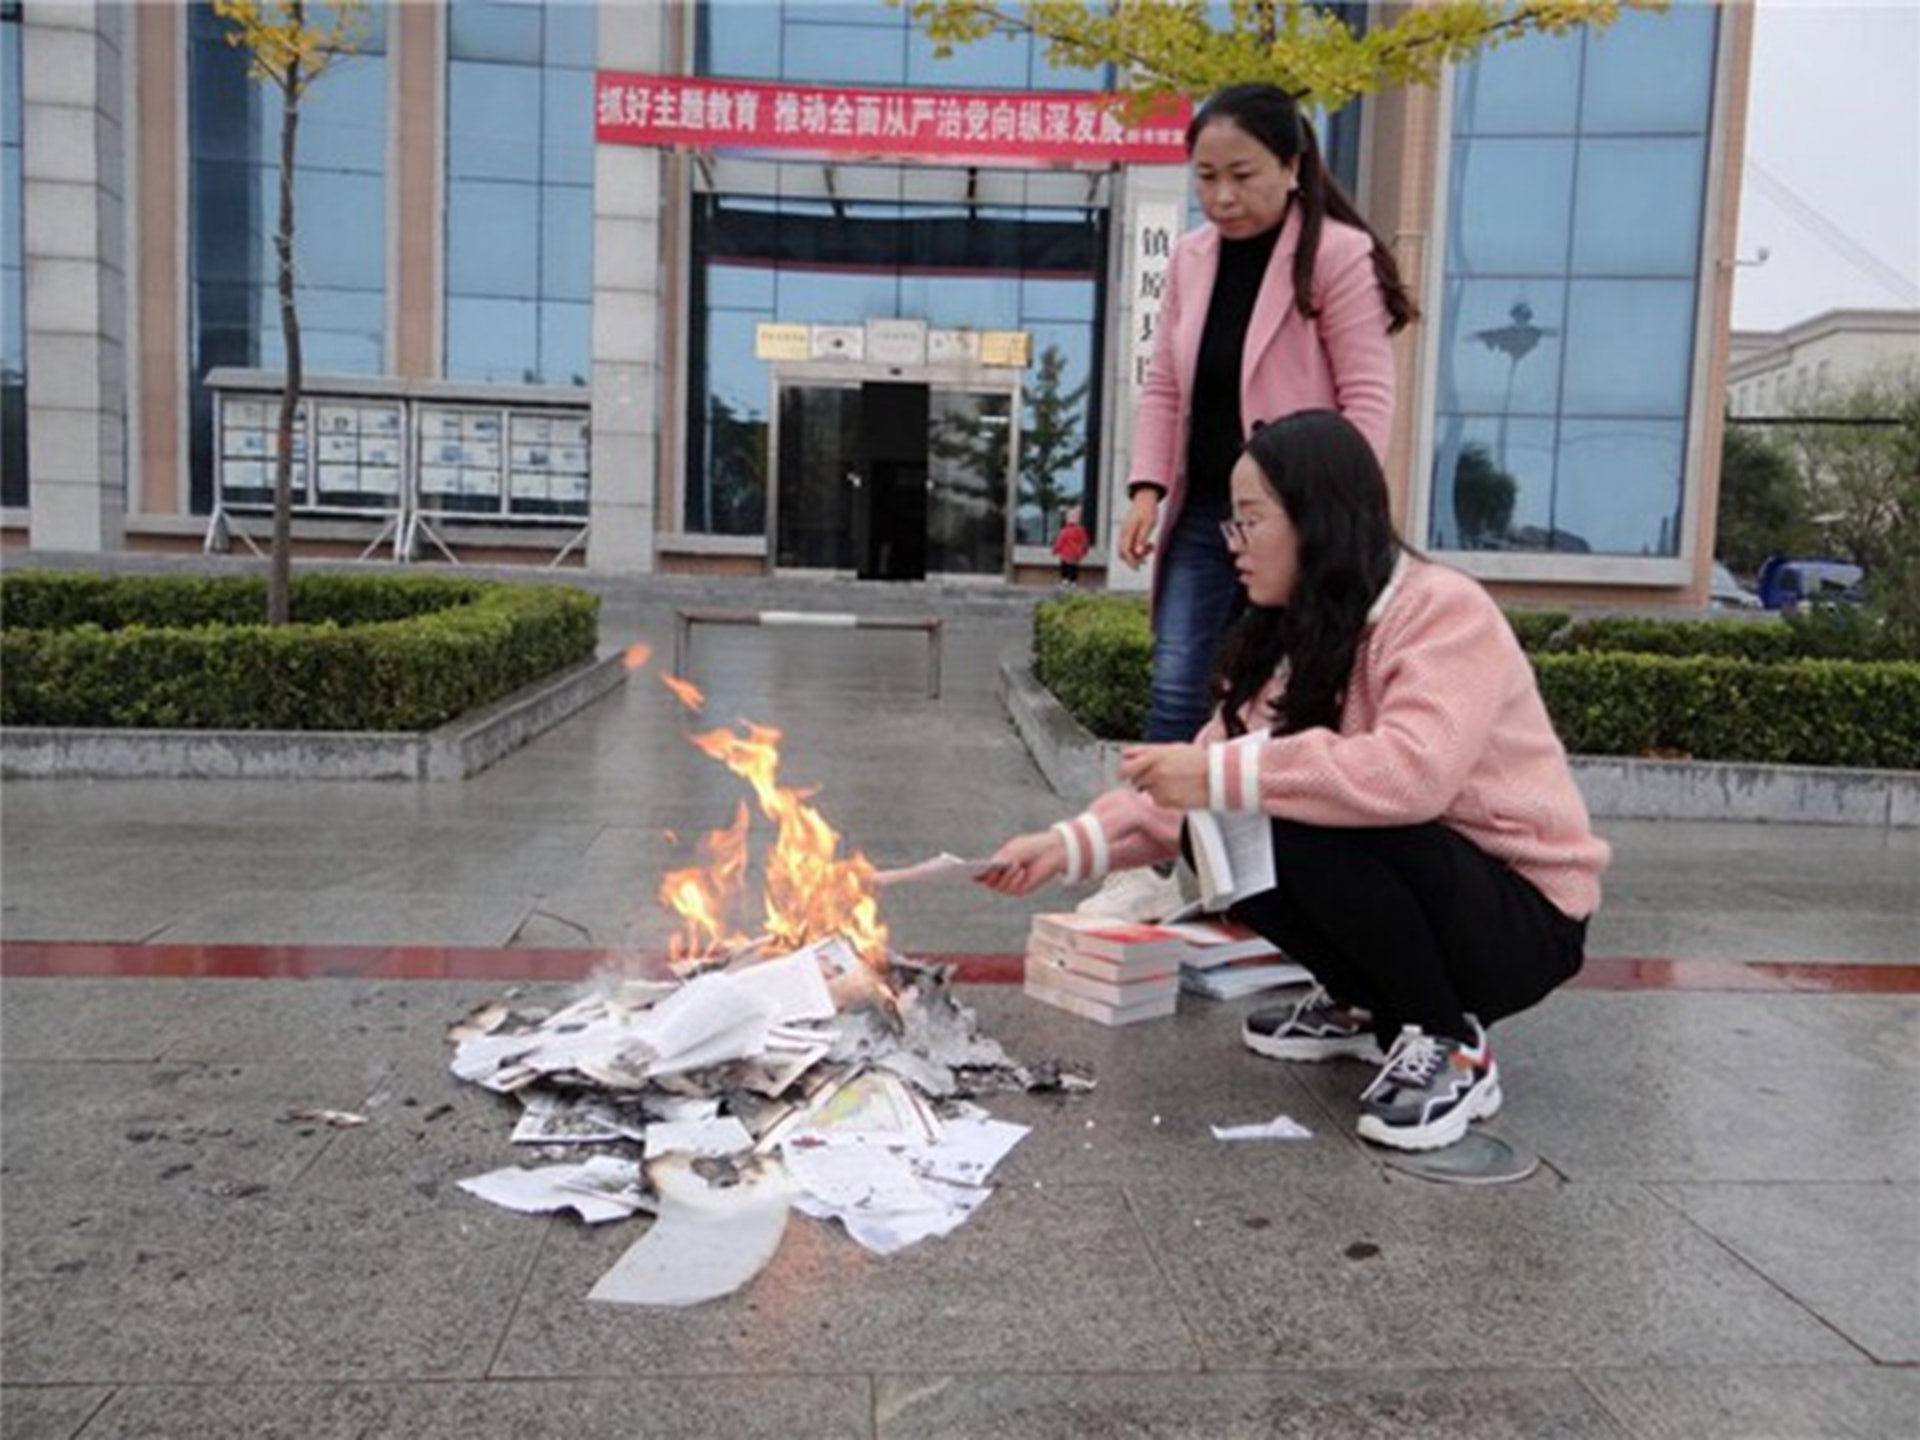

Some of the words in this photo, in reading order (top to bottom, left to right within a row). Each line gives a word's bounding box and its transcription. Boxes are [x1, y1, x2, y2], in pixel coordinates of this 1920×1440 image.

[598, 84, 760, 132] 抓好主题教育
